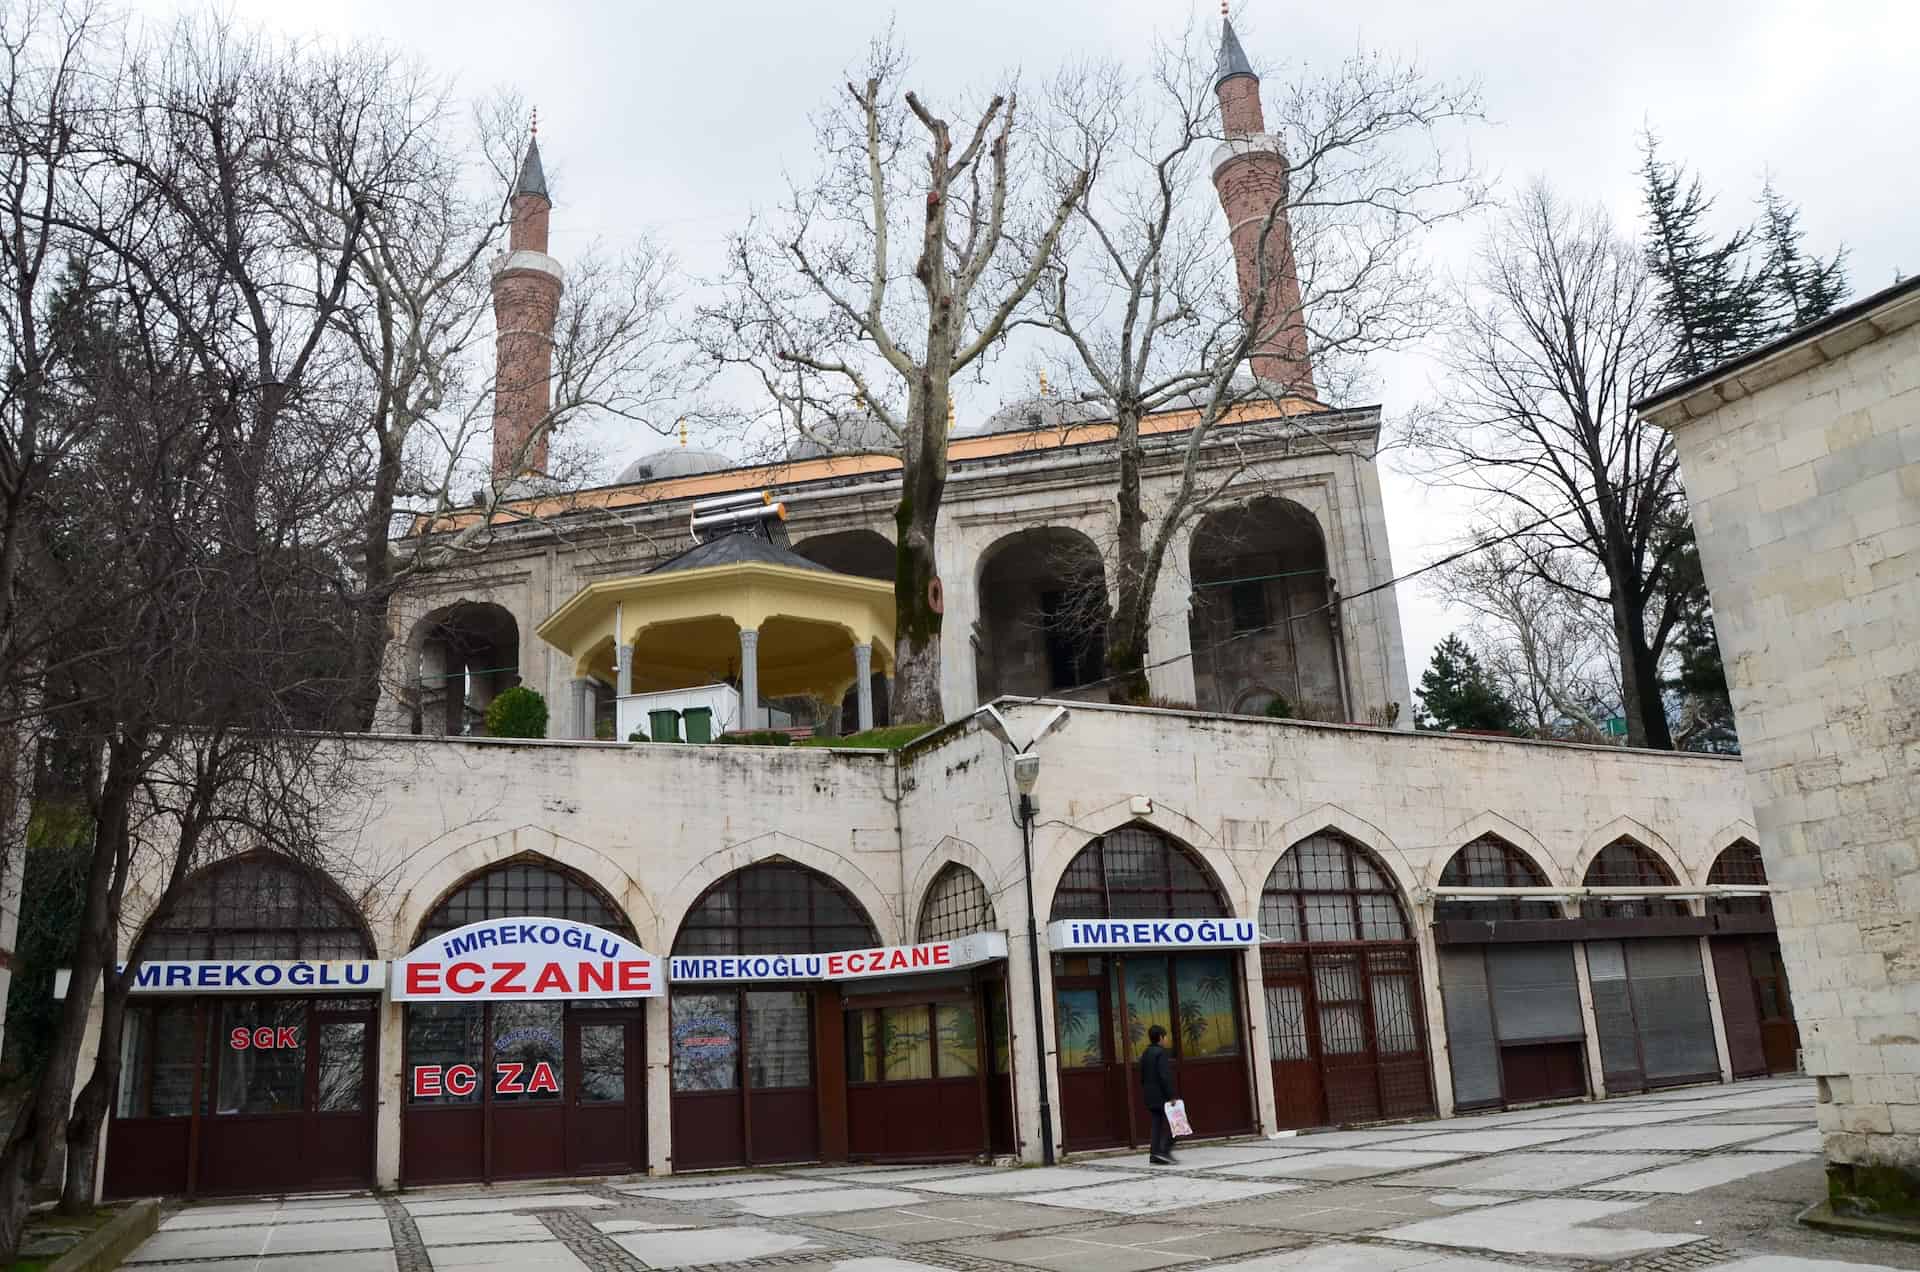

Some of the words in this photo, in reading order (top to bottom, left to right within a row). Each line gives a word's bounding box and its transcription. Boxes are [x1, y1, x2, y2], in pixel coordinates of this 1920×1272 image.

[828, 944, 950, 975] ECZANE
[406, 960, 652, 995] ECZANE
[230, 1026, 299, 1050] SGK
